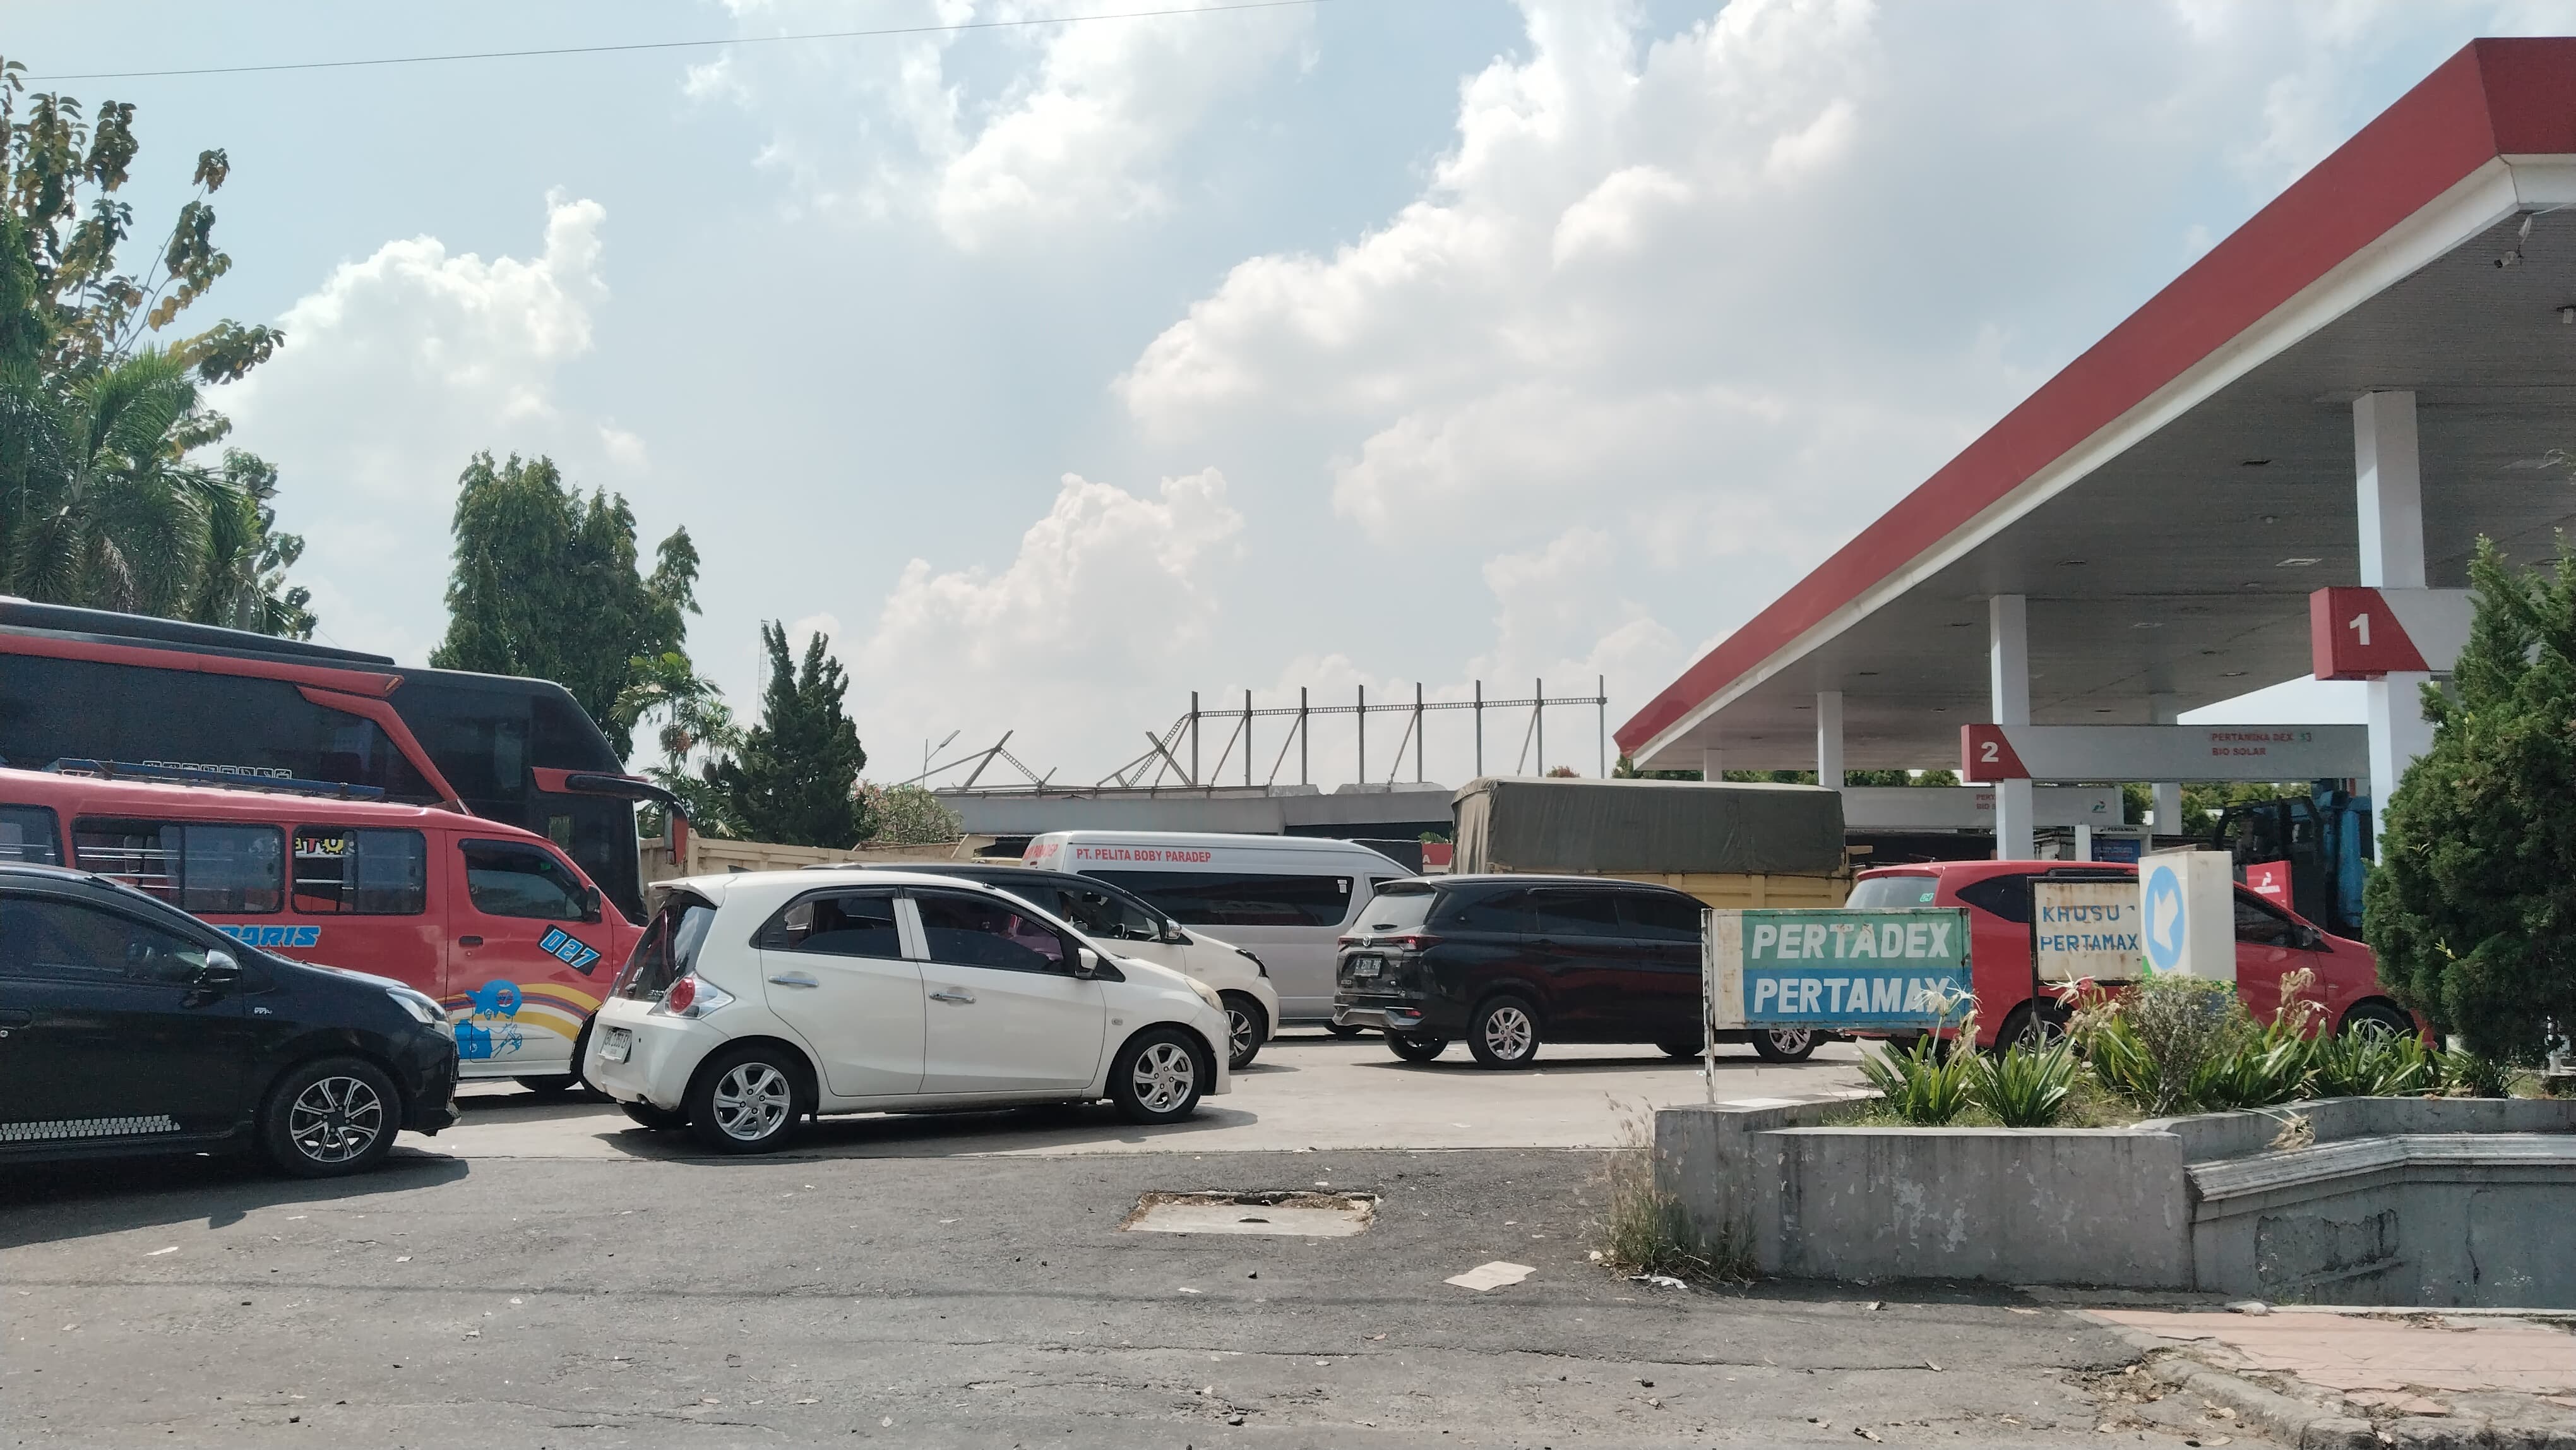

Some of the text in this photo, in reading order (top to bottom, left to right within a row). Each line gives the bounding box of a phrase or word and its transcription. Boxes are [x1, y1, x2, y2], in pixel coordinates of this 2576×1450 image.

[2349, 613, 2370, 645] 1
[2212, 733, 2270, 741] PERTAMINA
[2273, 733, 2294, 741] DEX
[1981, 741, 1999, 762] 2
[2212, 748, 2267, 756] BIO SOLAR
[1076, 848, 1211, 863] PT. PELITA BOBY PARADEP
[2042, 904, 2135, 923] KHUSU
[540, 928, 601, 968] 027
[1751, 922, 1952, 959] PERTADEX
[2040, 933, 2139, 952] PERTAMAX
[1753, 978, 1950, 1014] PERTAMAX
